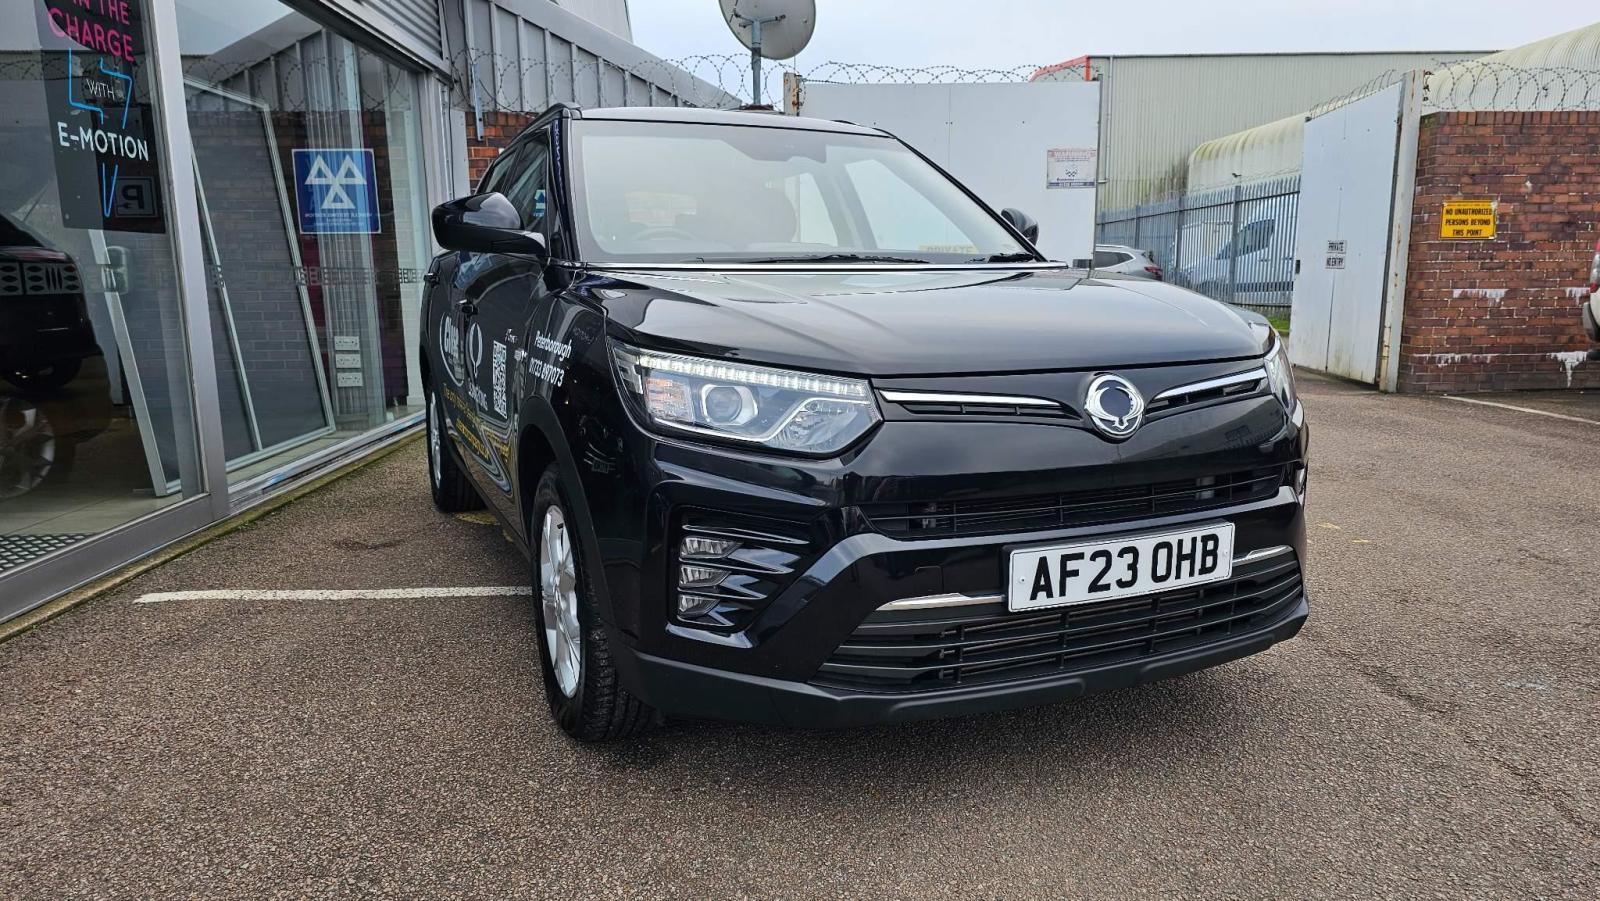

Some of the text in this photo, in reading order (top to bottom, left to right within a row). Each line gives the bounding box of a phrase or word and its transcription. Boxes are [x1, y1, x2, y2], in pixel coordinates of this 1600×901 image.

[99, 0, 130, 25] THE
[48, 7, 135, 62] CHARGE
[86, 79, 115, 100] WITH
[57, 121, 149, 161] E-MOTION
[1445, 208, 1492, 216] NO UNAUTHORIZED
[1445, 218, 1491, 226] PERSONS BEYOND
[534, 330, 572, 362] Peterborough
[1030, 533, 1219, 601] AF23 OHB
